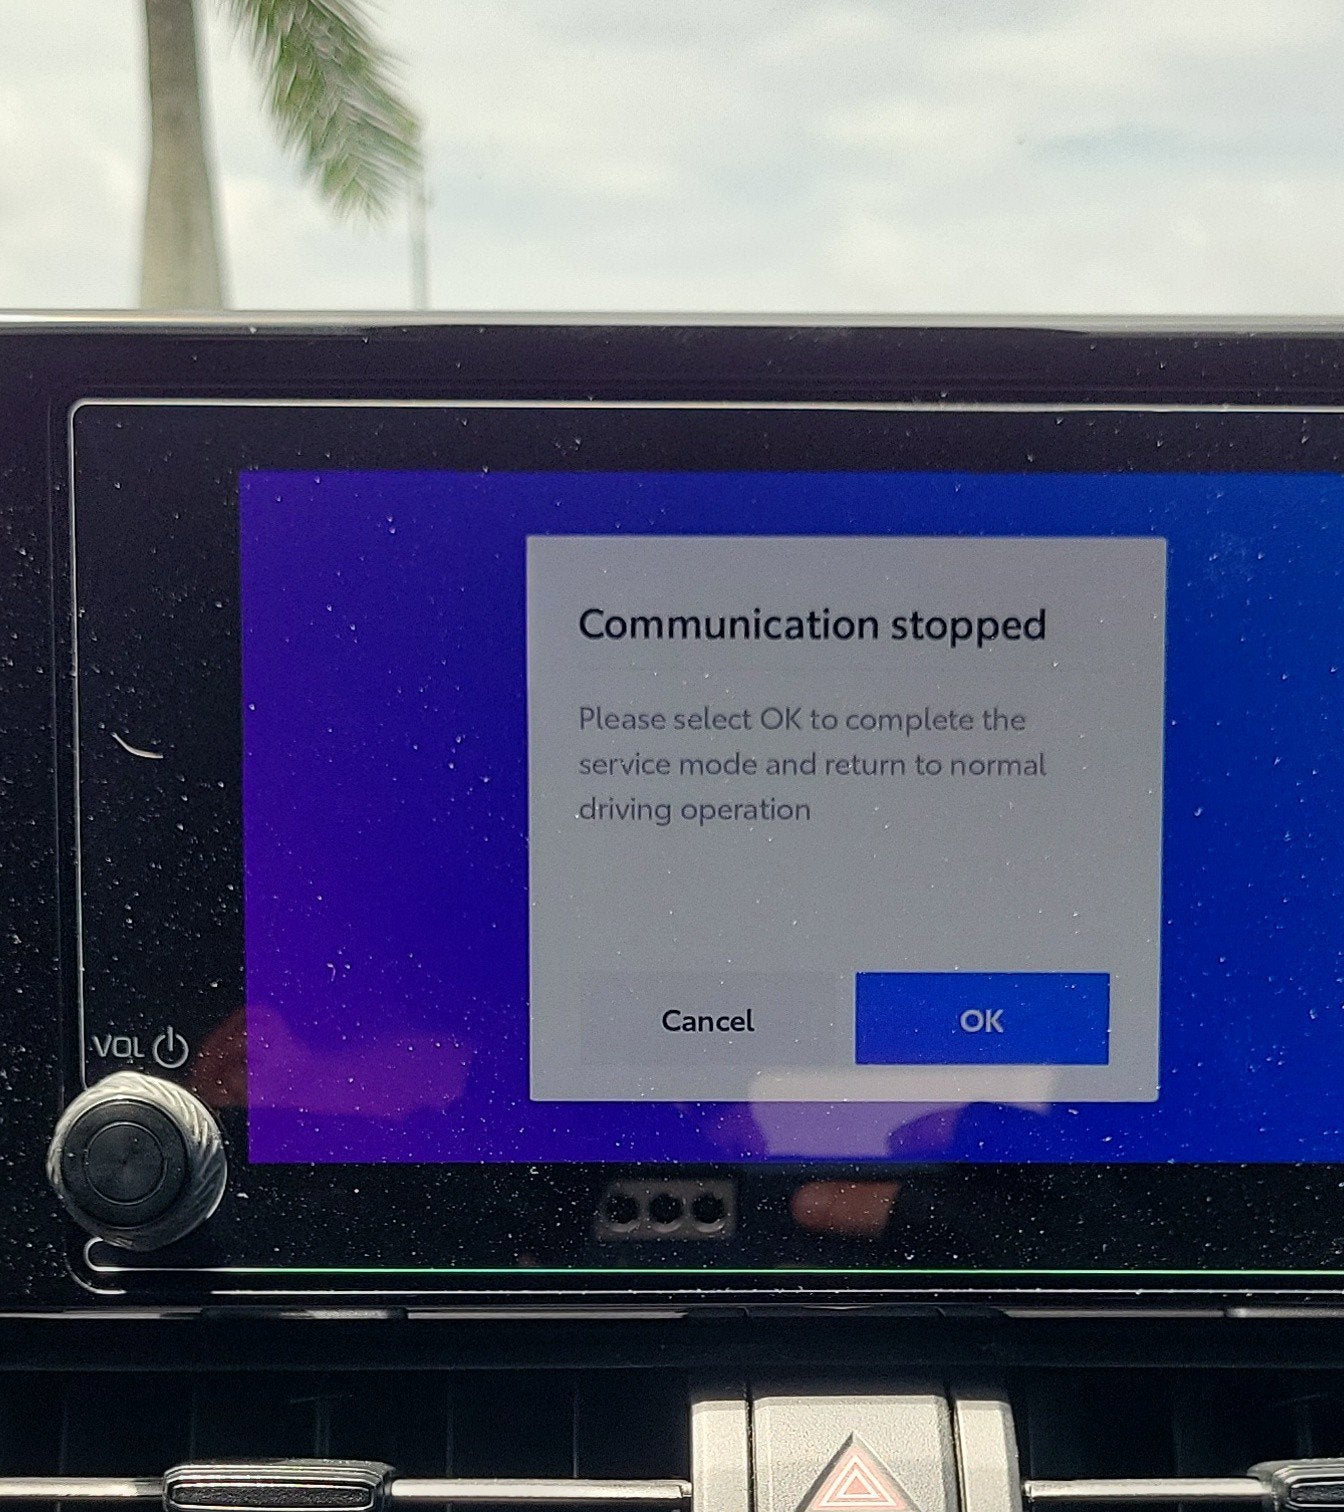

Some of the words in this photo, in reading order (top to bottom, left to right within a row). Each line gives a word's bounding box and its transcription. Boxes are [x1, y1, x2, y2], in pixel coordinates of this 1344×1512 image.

[578, 607, 880, 642] Communication
[890, 607, 1048, 649] stopped
[578, 706, 667, 732] Please
[673, 706, 752, 732] select
[759, 707, 803, 732] OK
[809, 710, 838, 732] to
[844, 706, 975, 738] complete
[981, 707, 1027, 732] the
[578, 753, 671, 777] service
[678, 752, 758, 777] mode
[765, 752, 817, 777] and
[824, 755, 906, 777] return
[914, 755, 943, 777] to
[949, 752, 1048, 777] normal
[578, 797, 672, 827] driving
[680, 799, 812, 827] operation
[661, 1009, 756, 1034] Cancel
[959, 1009, 1005, 1034] OK
[92, 1034, 145, 1057] VOL
